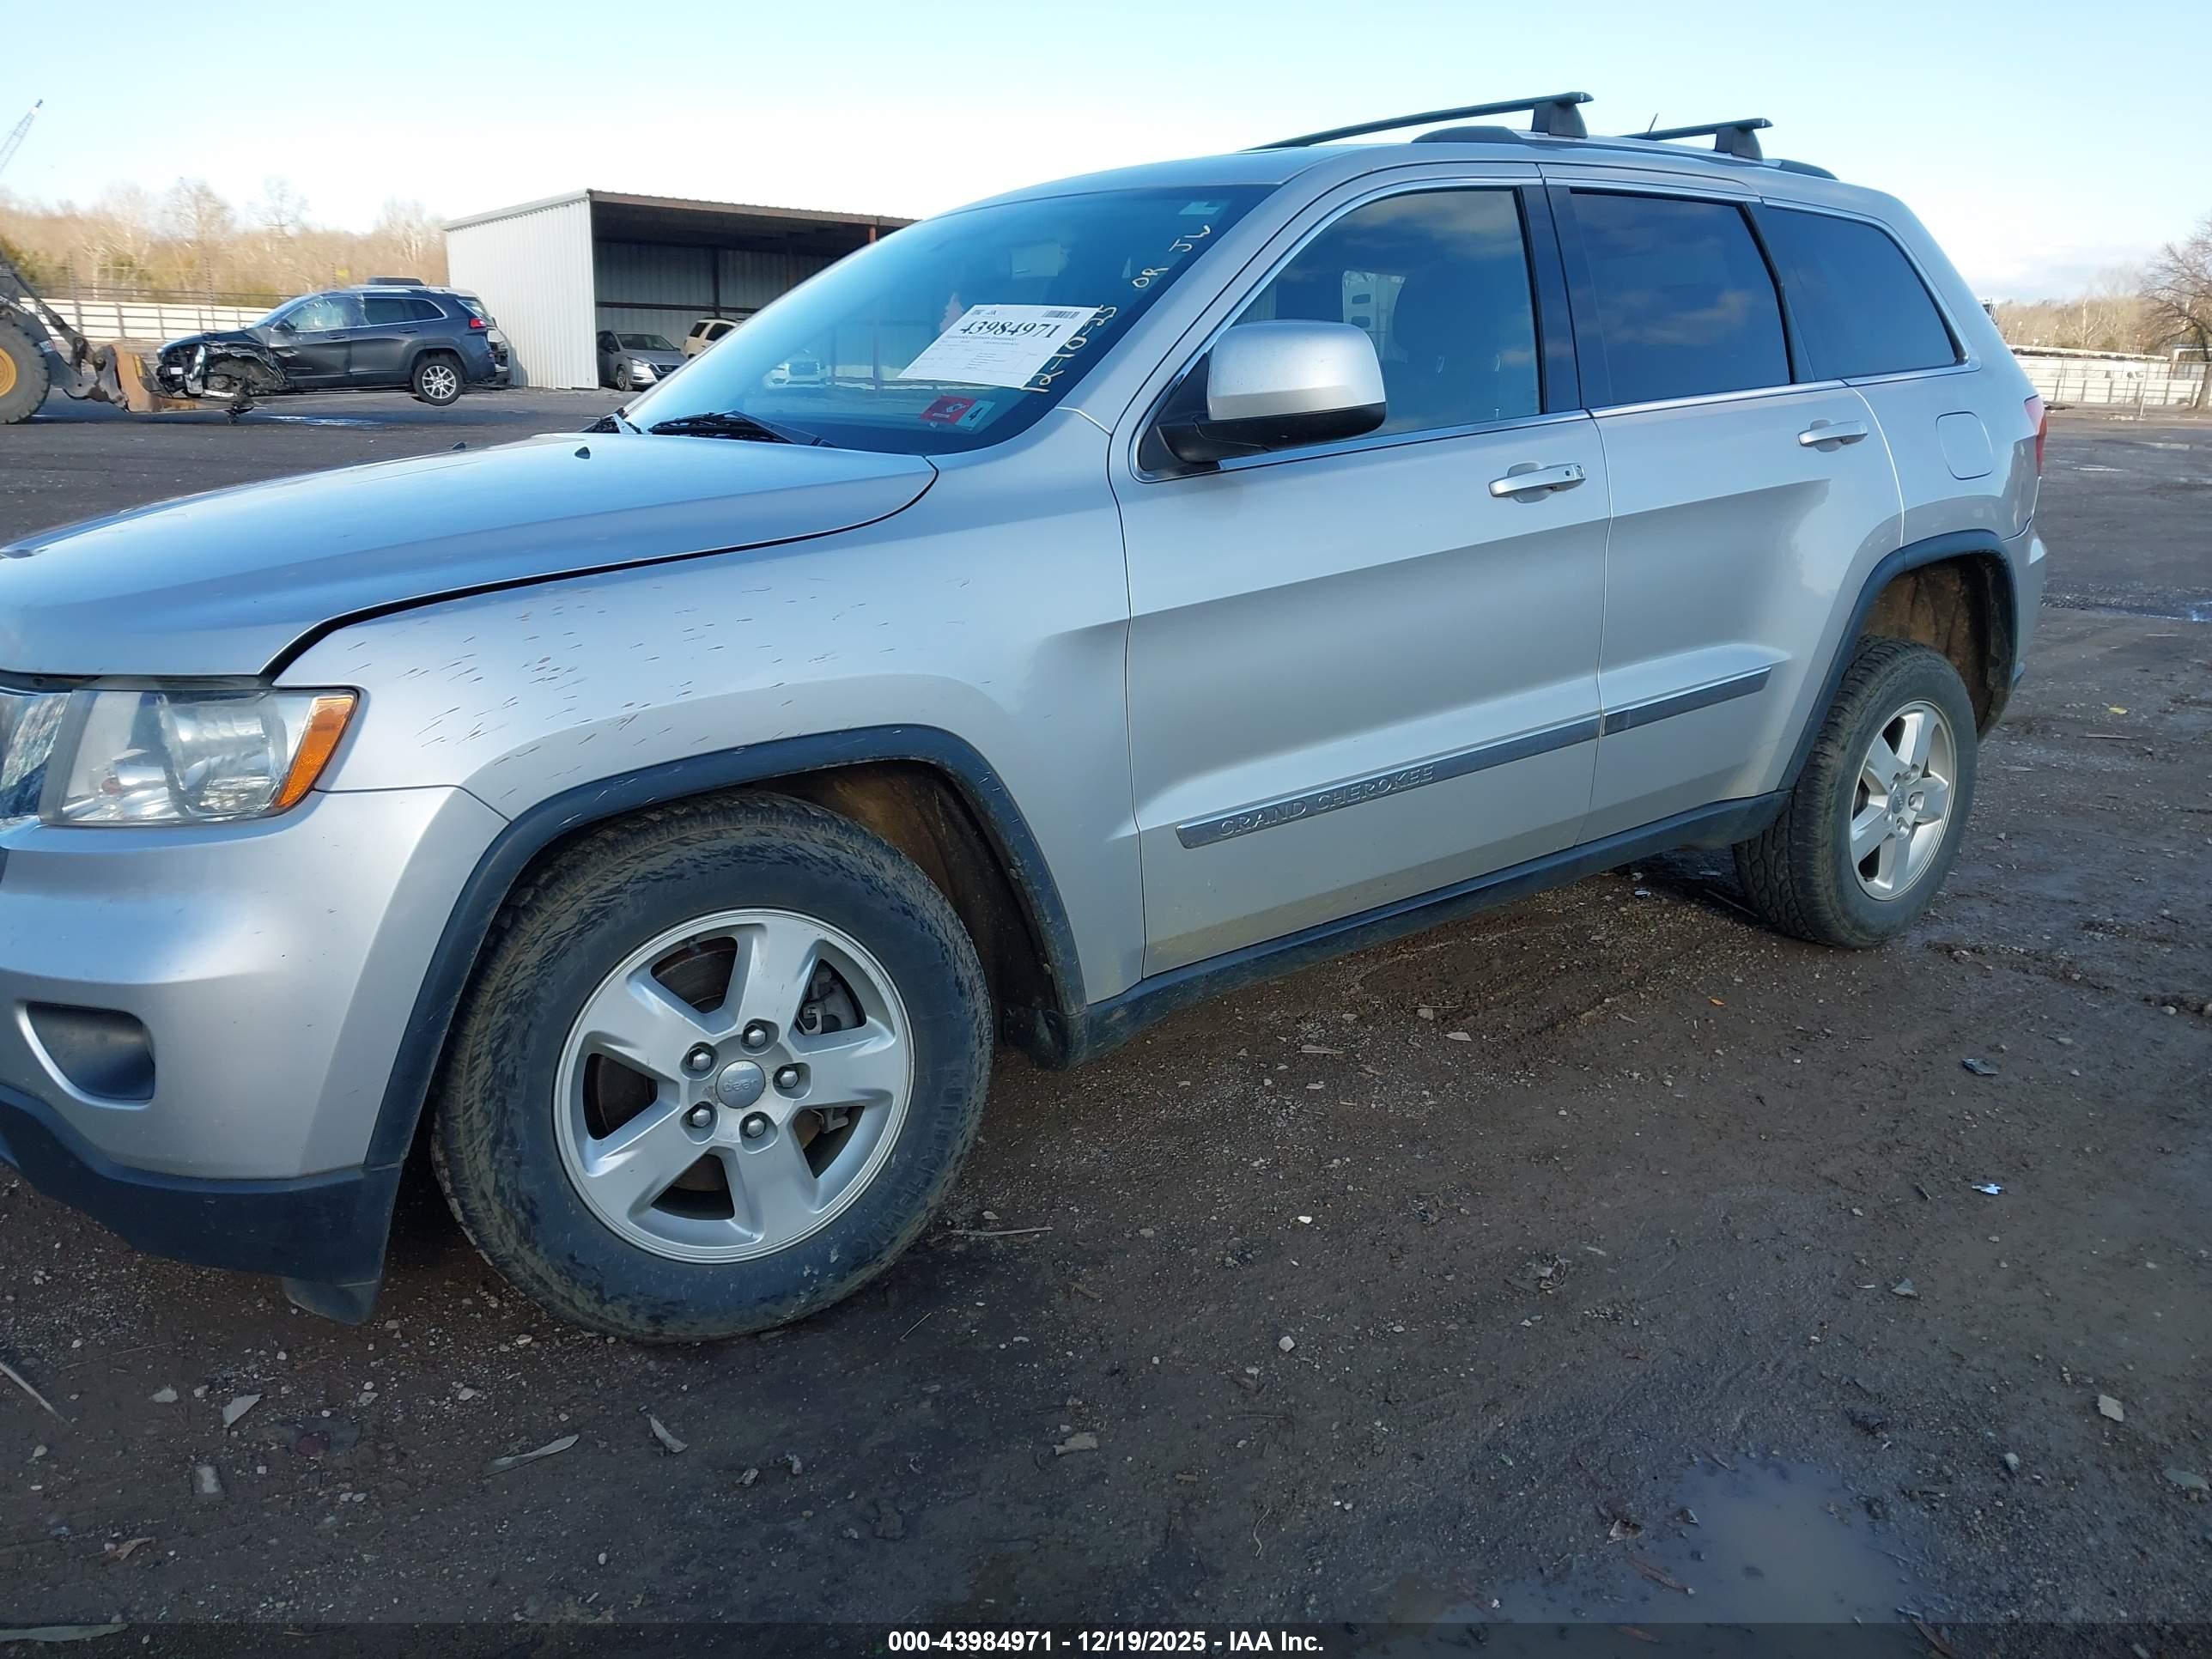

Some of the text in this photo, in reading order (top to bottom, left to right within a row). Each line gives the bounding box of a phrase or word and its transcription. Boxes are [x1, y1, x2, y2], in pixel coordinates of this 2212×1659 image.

[959, 320, 1062, 339] 43984971
[1219, 765, 1435, 837] GRAND CHEROKEE
